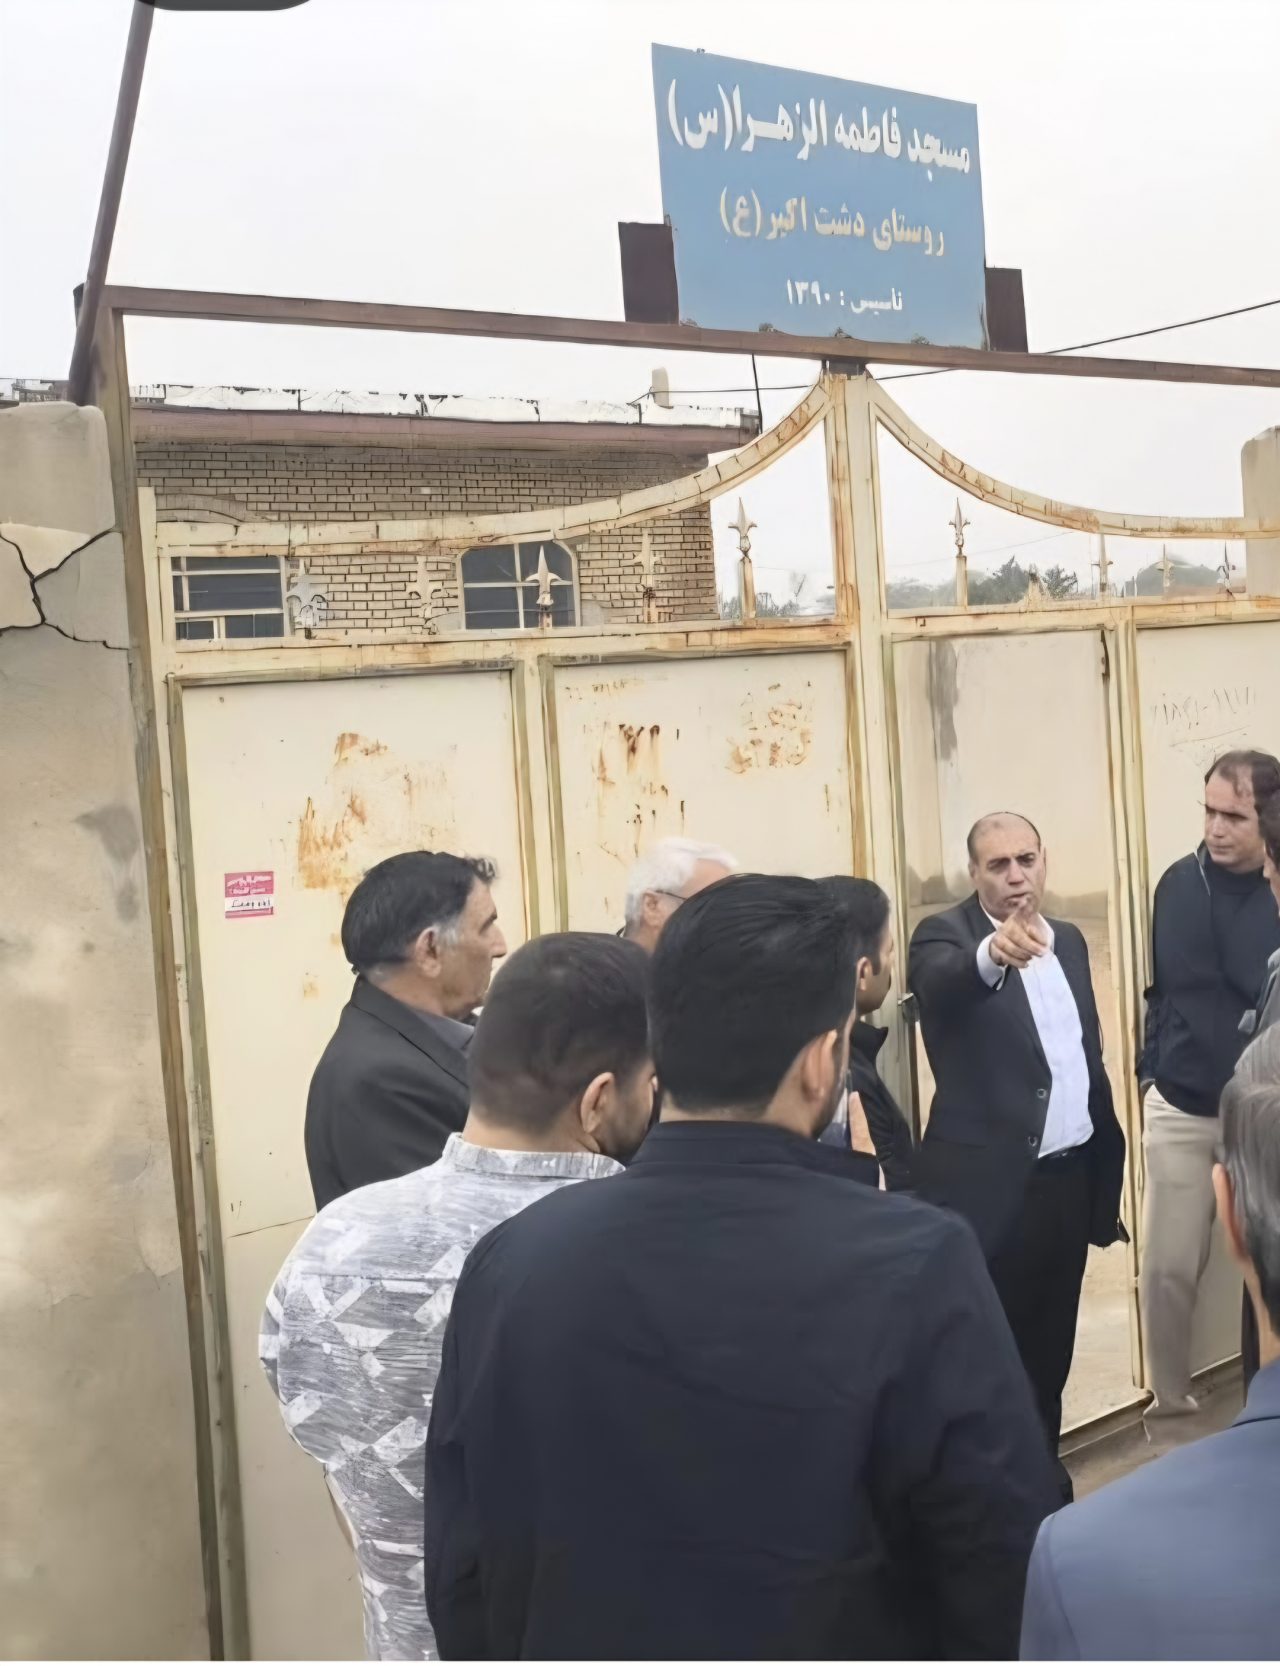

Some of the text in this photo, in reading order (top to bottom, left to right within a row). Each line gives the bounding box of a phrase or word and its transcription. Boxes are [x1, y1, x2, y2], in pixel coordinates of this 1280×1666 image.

[834, 106, 902, 159] فاطمه
[907, 128, 970, 182] مسجد
[814, 202, 865, 237] دشت
[872, 207, 944, 256] روستای
[786, 279, 831, 305] ۱۳۹۰
[850, 287, 903, 315] تاسیس
